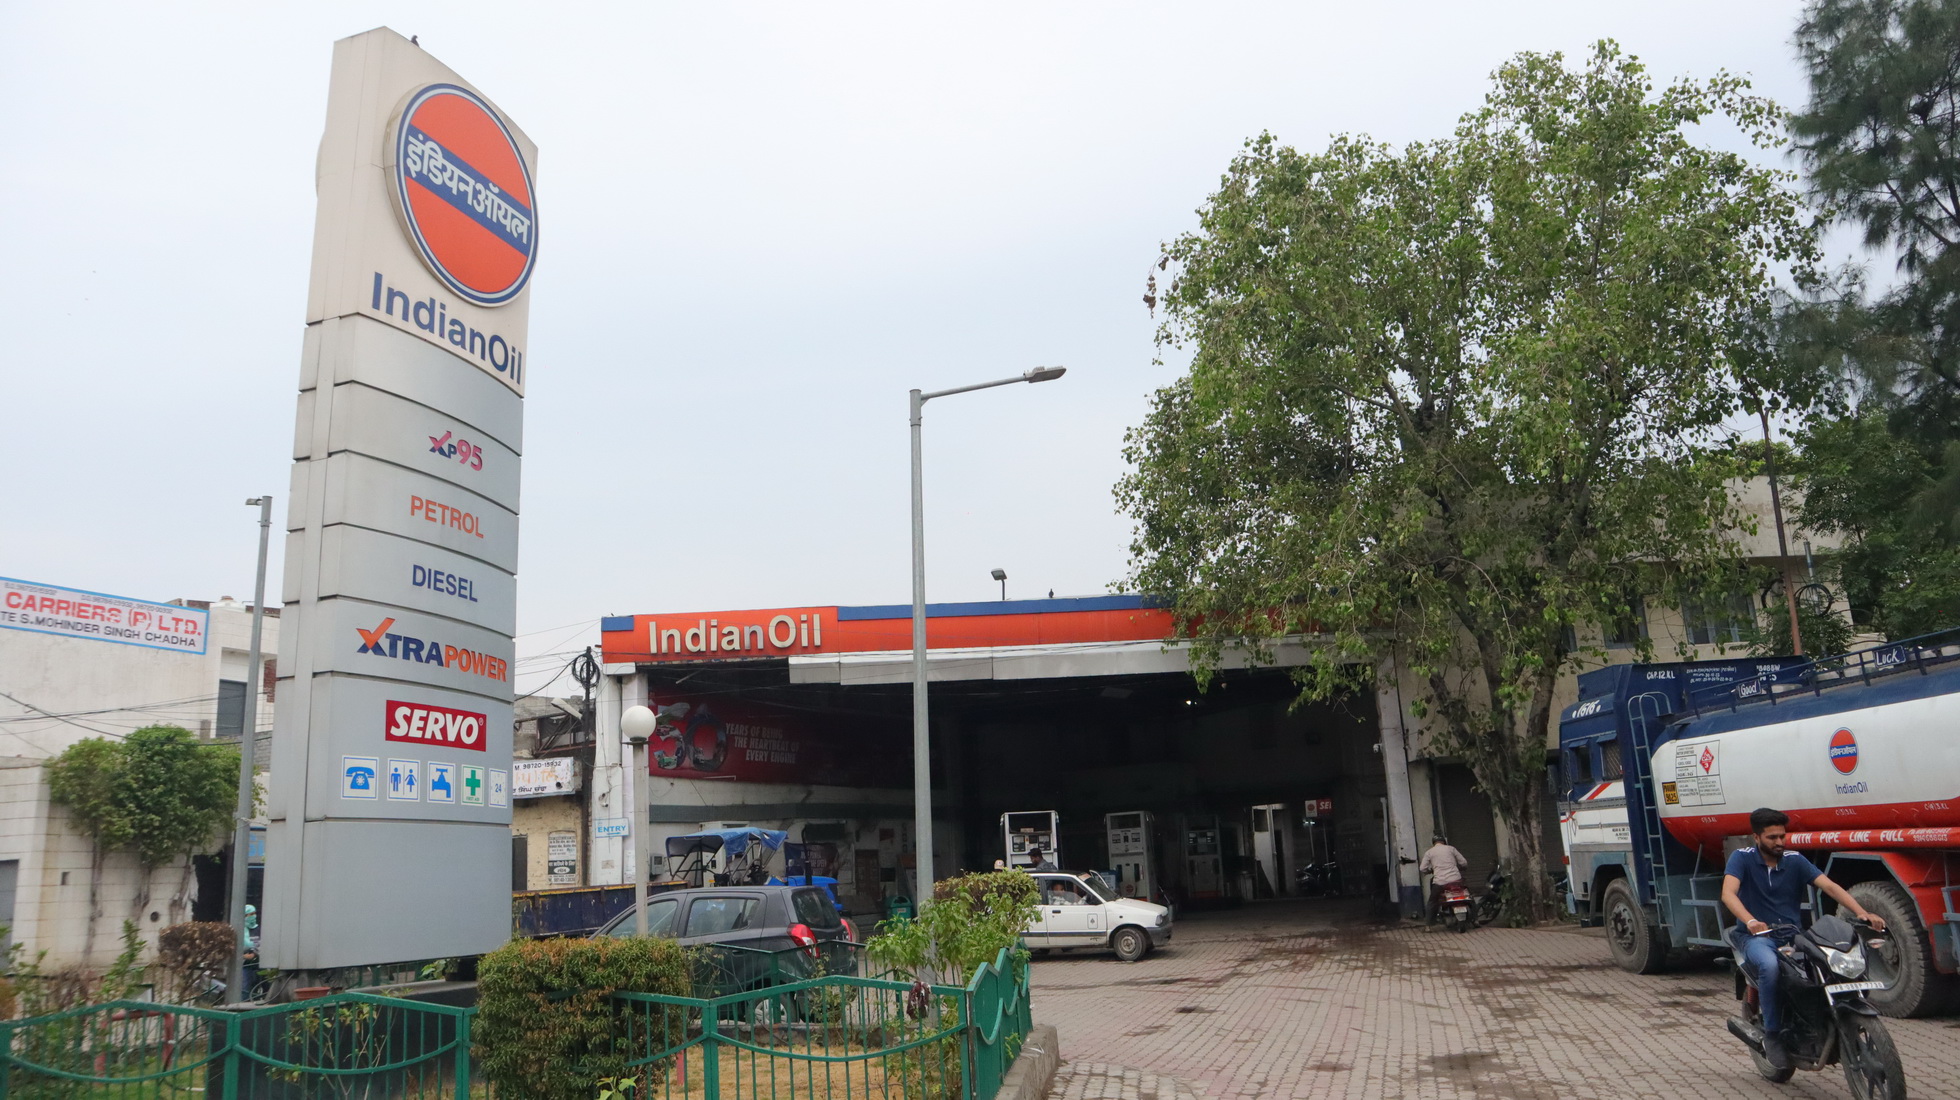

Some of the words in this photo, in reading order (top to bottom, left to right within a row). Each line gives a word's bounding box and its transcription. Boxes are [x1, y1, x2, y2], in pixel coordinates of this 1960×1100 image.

[405, 133, 531, 245] इंडियनऑयल
[371, 271, 523, 386] IndianOil
[410, 494, 484, 539] PETROL
[412, 564, 478, 603] DIESEL
[5, 591, 122, 624] CARRIERS
[128, 608, 153, 630] (P)
[158, 615, 203, 637] LTD.
[103, 625, 140, 639] SINGH
[145, 632, 196, 647] CHADHA
[649, 613, 822, 654] IndianOil
[355, 616, 508, 683] XTRAPOWER
[1740, 680, 1757, 696] Good
[390, 705, 479, 745] SERVO
[725, 723, 749, 736] YEARS
[750, 726, 760, 737] OF
[734, 735, 747, 748] THE
[749, 737, 790, 751] HEARTBEAT
[745, 749, 769, 762] EVERY
[770, 751, 796, 764] ENGINE
[495, 783, 502, 793] 24
[1835, 781, 1869, 795] IndianOil
[597, 825, 626, 834] ENTRY
[1790, 832, 1811, 844] WITH
[1819, 831, 1842, 844] PIPE
[1849, 830, 1872, 843] LINE
[1879, 829, 1905, 842] FULL
